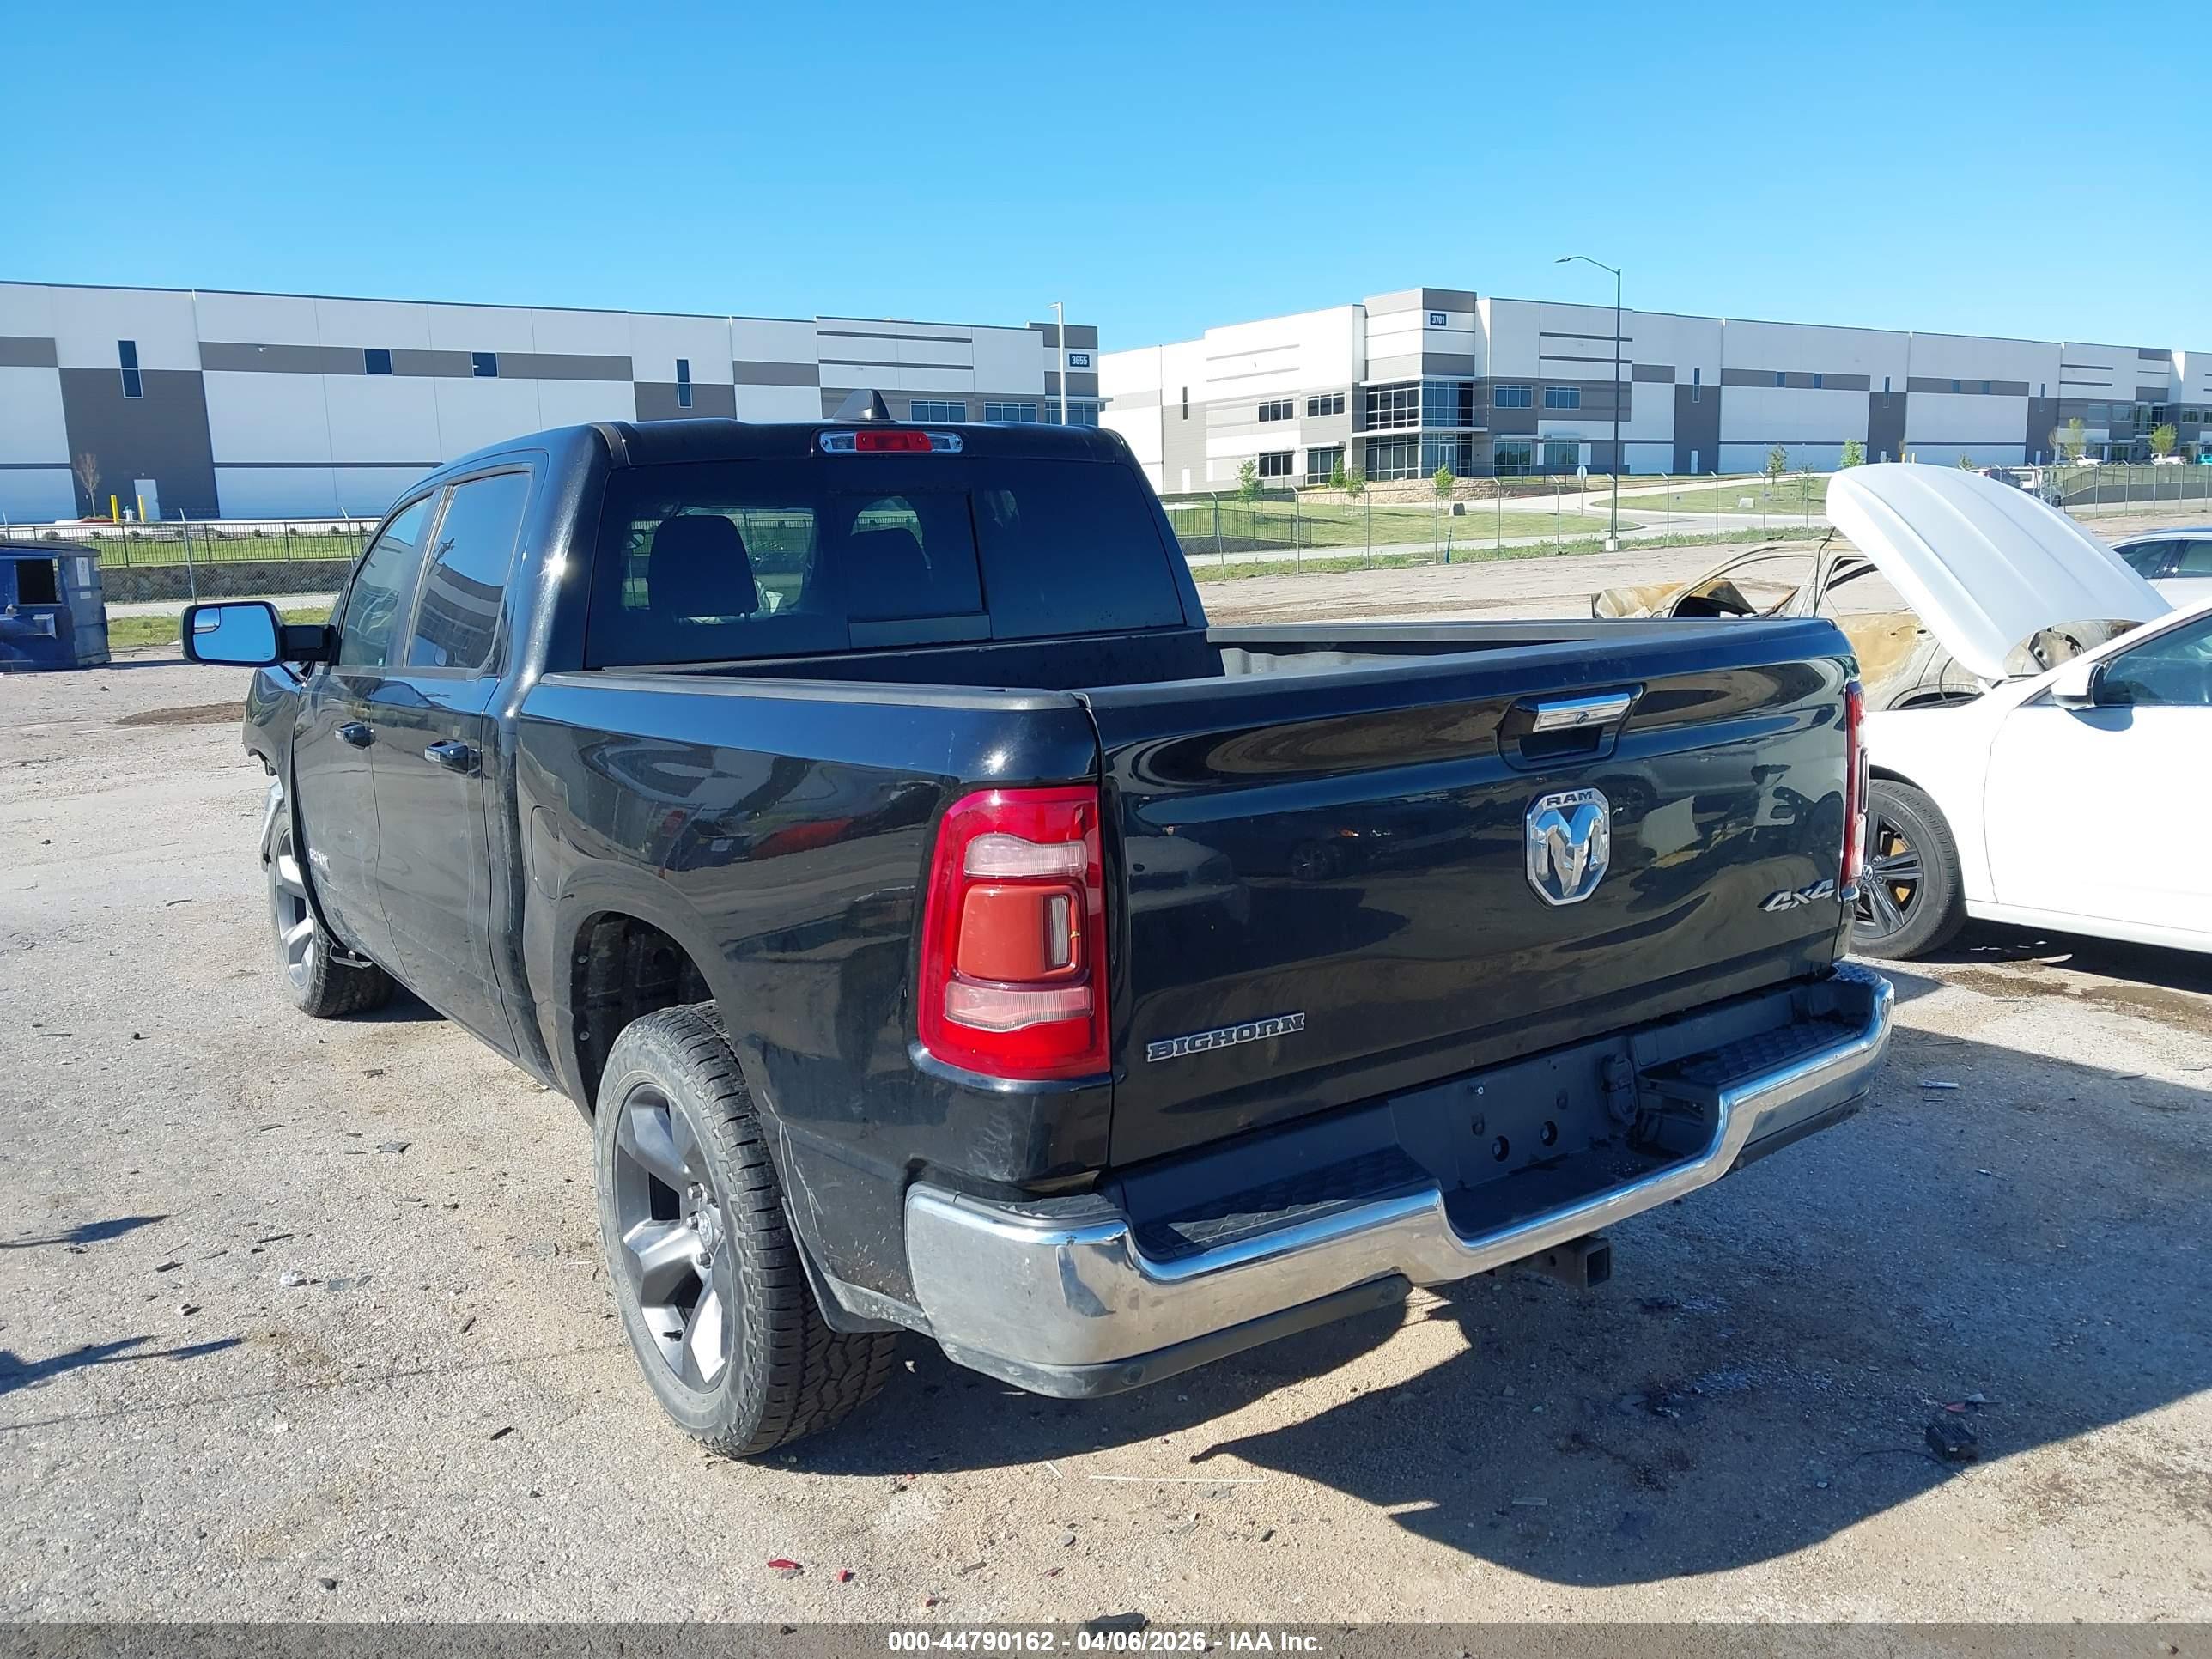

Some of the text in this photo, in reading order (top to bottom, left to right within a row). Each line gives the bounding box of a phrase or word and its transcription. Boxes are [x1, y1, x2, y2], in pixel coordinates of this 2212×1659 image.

[1431, 315, 1445, 325] 3701
[1071, 356, 1088, 365] 3655
[1546, 791, 1594, 806] RAM
[1147, 1012, 1305, 1062] BIGHORN
